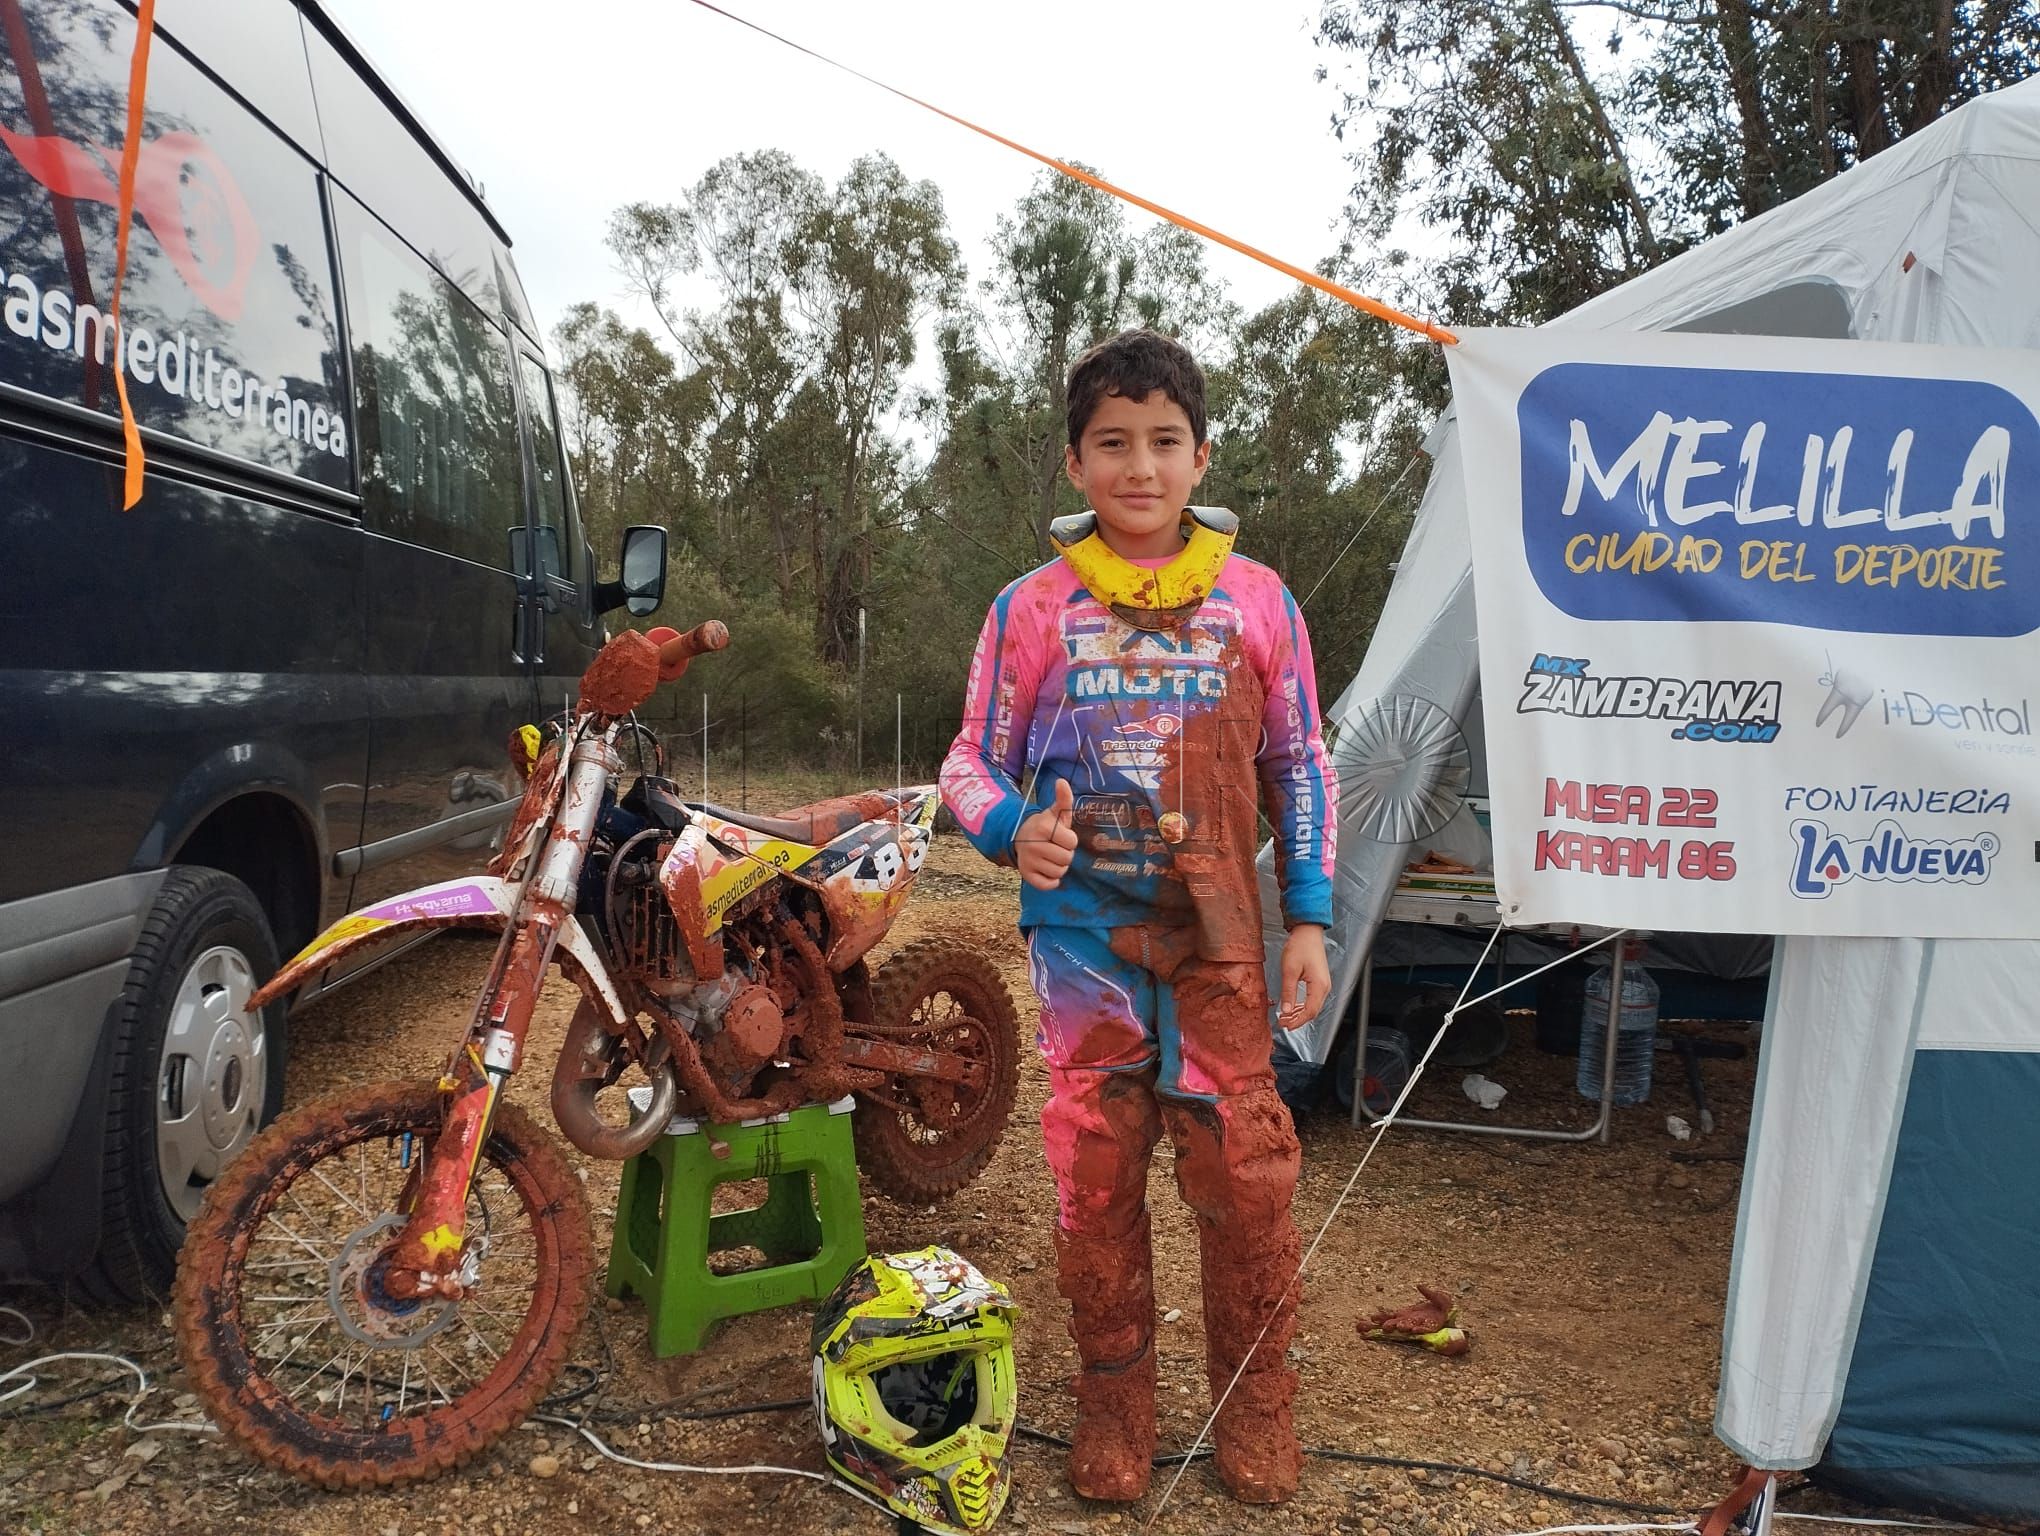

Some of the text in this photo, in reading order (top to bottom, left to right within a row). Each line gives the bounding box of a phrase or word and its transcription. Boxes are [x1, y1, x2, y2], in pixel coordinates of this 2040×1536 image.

[0, 267, 347, 459] asmediterránea
[1560, 410, 2011, 541] MELILLA
[1564, 531, 2007, 591] CIUDAD DEL DEPORTE
[1075, 667, 1228, 698] MOTO
[1531, 653, 1590, 676] MX
[1517, 671, 1782, 722] ZAMBRANA
[1882, 689, 2032, 736] i+Dental
[1671, 721, 1782, 743] .COM
[1545, 777, 1719, 829] MUSA 22
[1534, 829, 1738, 881] KARAM 86
[1800, 824, 1851, 893] LA
[1862, 829, 1985, 877] NUEVA
